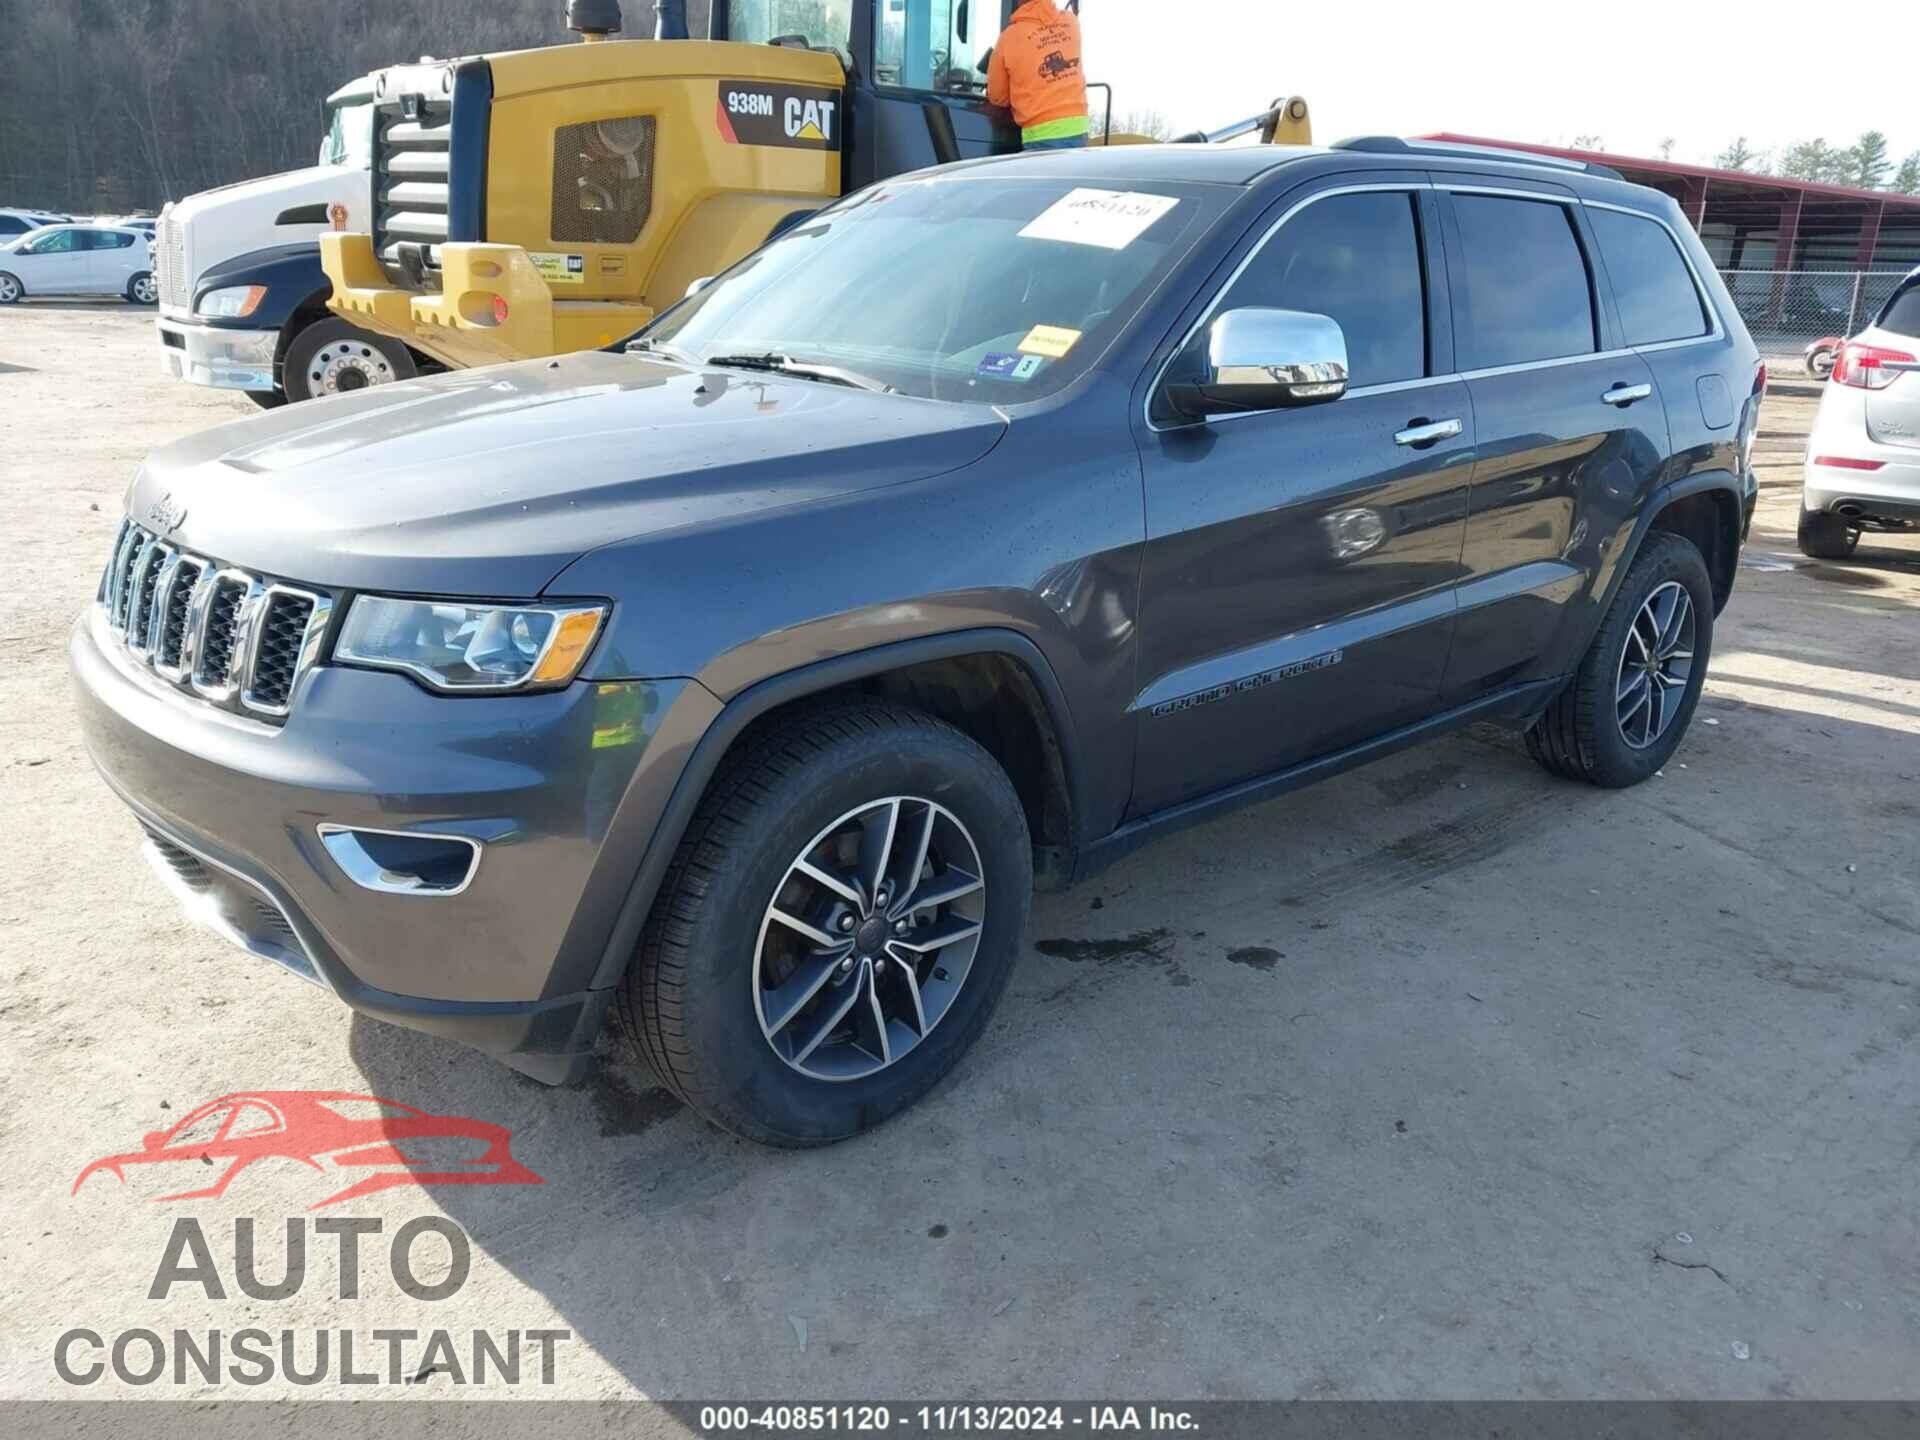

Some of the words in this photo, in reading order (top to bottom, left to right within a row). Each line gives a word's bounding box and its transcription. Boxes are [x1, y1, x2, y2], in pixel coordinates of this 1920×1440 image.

[728, 91, 773, 116] 938M
[784, 97, 835, 140] CAT
[1151, 683, 1233, 718] GRAND
